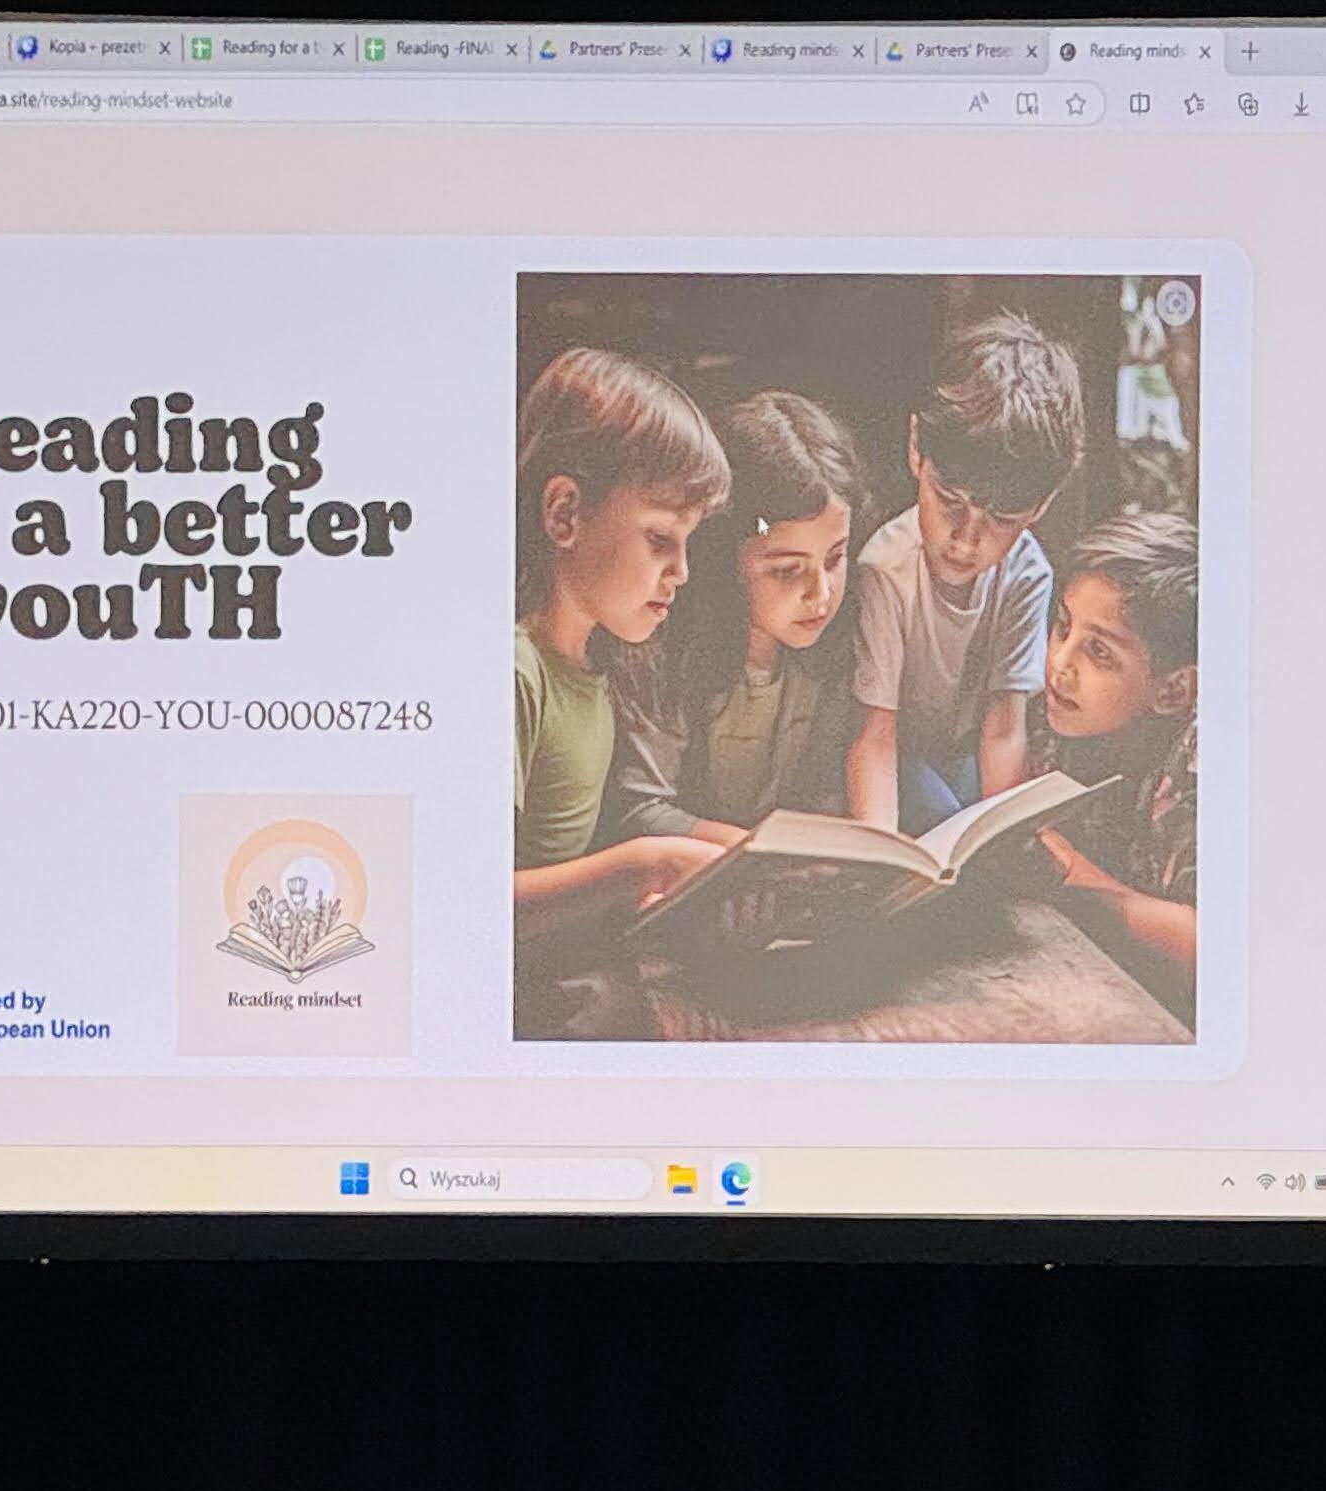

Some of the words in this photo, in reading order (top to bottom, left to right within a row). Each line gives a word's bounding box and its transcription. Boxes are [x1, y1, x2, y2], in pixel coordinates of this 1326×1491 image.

[49, 39, 86, 54] Kopia
[223, 40, 276, 57] Reading
[279, 40, 299, 55] for
[301, 43, 310, 55] a
[396, 41, 449, 58] Reading
[742, 42, 796, 59] Reading
[916, 43, 972, 58] Partners'
[1090, 43, 1142, 61] Reading
[11, 500, 71, 556] a
[99, 479, 413, 557] better
[22, 992, 46, 1014] by
[228, 991, 294, 1011] Reading
[298, 991, 363, 1008] mindset
[51, 1019, 111, 1038] Union
[430, 1171, 501, 1189] Wyszukaj
